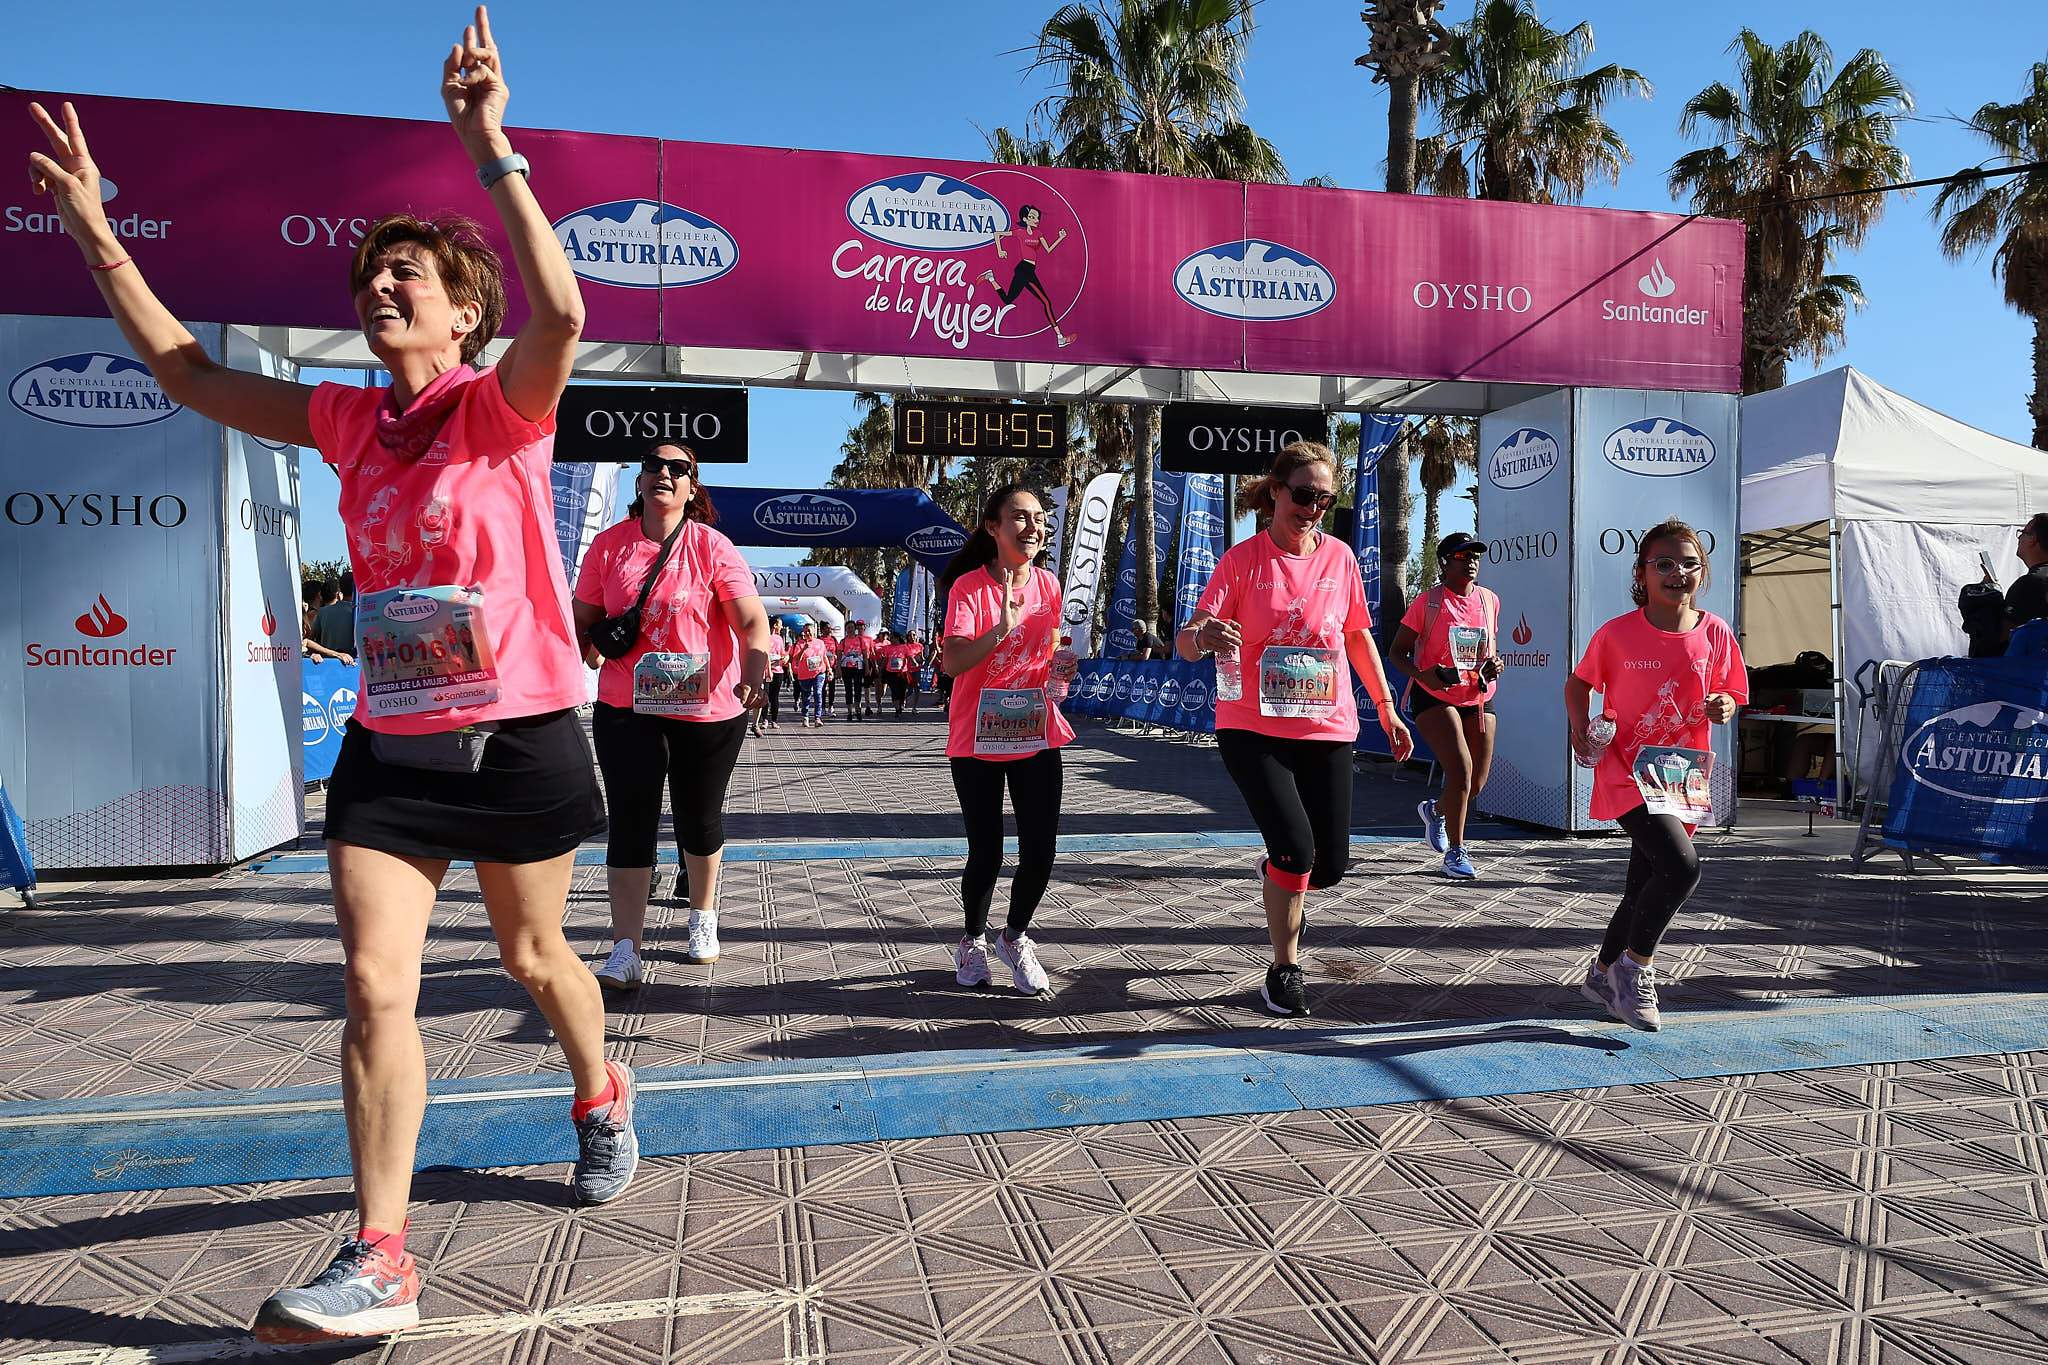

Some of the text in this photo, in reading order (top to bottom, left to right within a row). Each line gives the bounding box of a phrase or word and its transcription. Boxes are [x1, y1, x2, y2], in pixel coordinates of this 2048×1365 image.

[859, 196, 997, 234] ASTURIANA
[885, 196, 993, 211] CENTRAL LECHERA
[5, 206, 172, 239] Sannder
[281, 215, 372, 247] OYS
[589, 227, 650, 239] CENTRAL
[564, 228, 724, 268] ASTURIANA
[831, 239, 967, 287] Carrera
[1211, 265, 1319, 279] CENTRAL LECHERA
[1186, 265, 1324, 302] ASTURIANA
[1413, 281, 1532, 313] OYSHO
[864, 284, 1016, 350] de la Mujer
[1602, 299, 1709, 326] Santander
[22, 378, 173, 410] ASTURIANA
[50, 377, 159, 389] CENTRAL LECHER
[585, 410, 721, 440] OYSHO
[906, 409, 1054, 449] 01:04:55
[1611, 438, 1707, 463] ASTURIANA
[1492, 452, 1554, 480] ASTURIANA
[5, 492, 187, 528] OYSHO
[240, 498, 294, 540] OYSHO
[761, 505, 849, 526] ASTURIANA
[911, 536, 965, 549] ASTURIANA
[1489, 531, 1557, 565] OYSHO
[1064, 496, 1109, 625] OYSHO
[1256, 581, 1289, 590] OYSHO
[387, 603, 436, 618] ASTURIANA
[26, 643, 177, 667] Santander
[248, 641, 291, 663] Santander
[399, 639, 446, 663] 016
[1497, 649, 1551, 668] antander
[416, 666, 434, 677] 218
[1624, 660, 1662, 669] OYSHO
[371, 684, 400, 694] CARRERA
[401, 682, 410, 690] DE
[412, 681, 421, 689] LA
[423, 676, 448, 687] MUJER
[454, 671, 490, 683] VALENCIA
[1286, 677, 1315, 690] 016
[379, 688, 487, 709] OYSHO Santander
[1947, 732, 2009, 745] CENTRAL
[1914, 733, 2048, 780] ASTURIA
